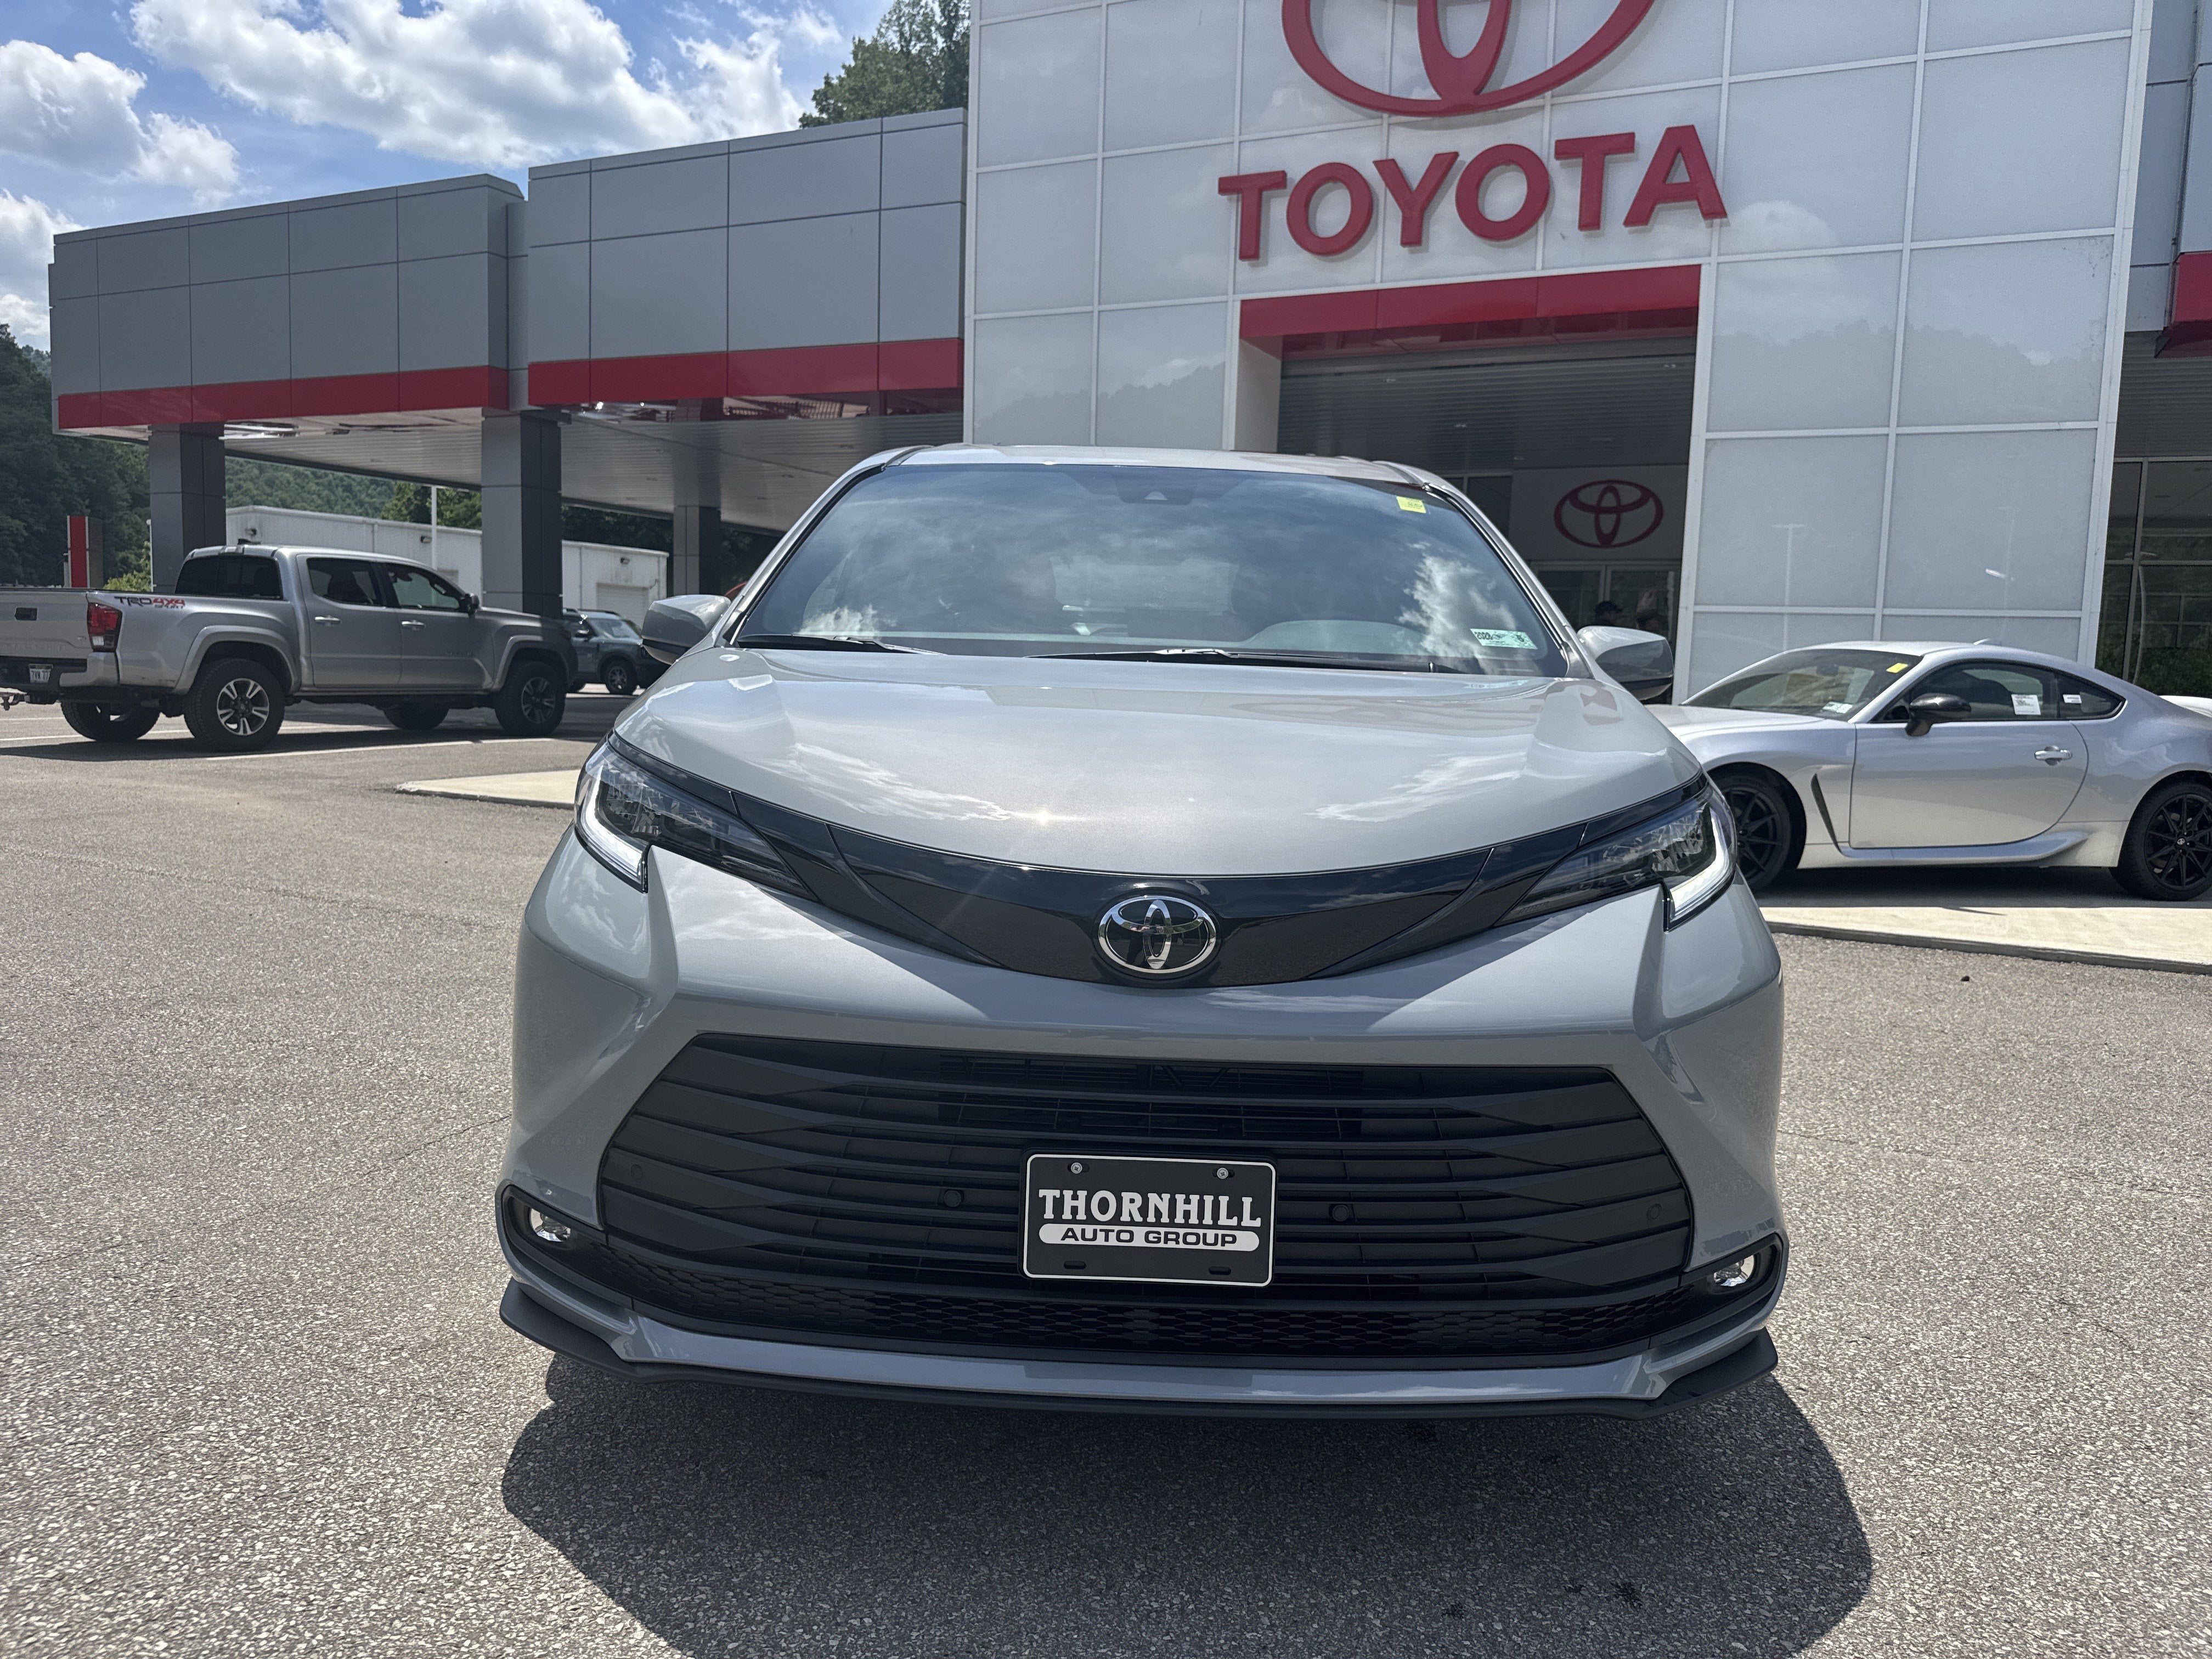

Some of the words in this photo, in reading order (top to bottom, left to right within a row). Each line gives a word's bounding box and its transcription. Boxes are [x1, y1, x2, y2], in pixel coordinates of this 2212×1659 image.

[1218, 125, 1727, 261] TOYOTA
[1038, 1189, 1261, 1227] THORNHILL
[1060, 1227, 1135, 1243] AUTO
[1144, 1230, 1237, 1248] GROUP
